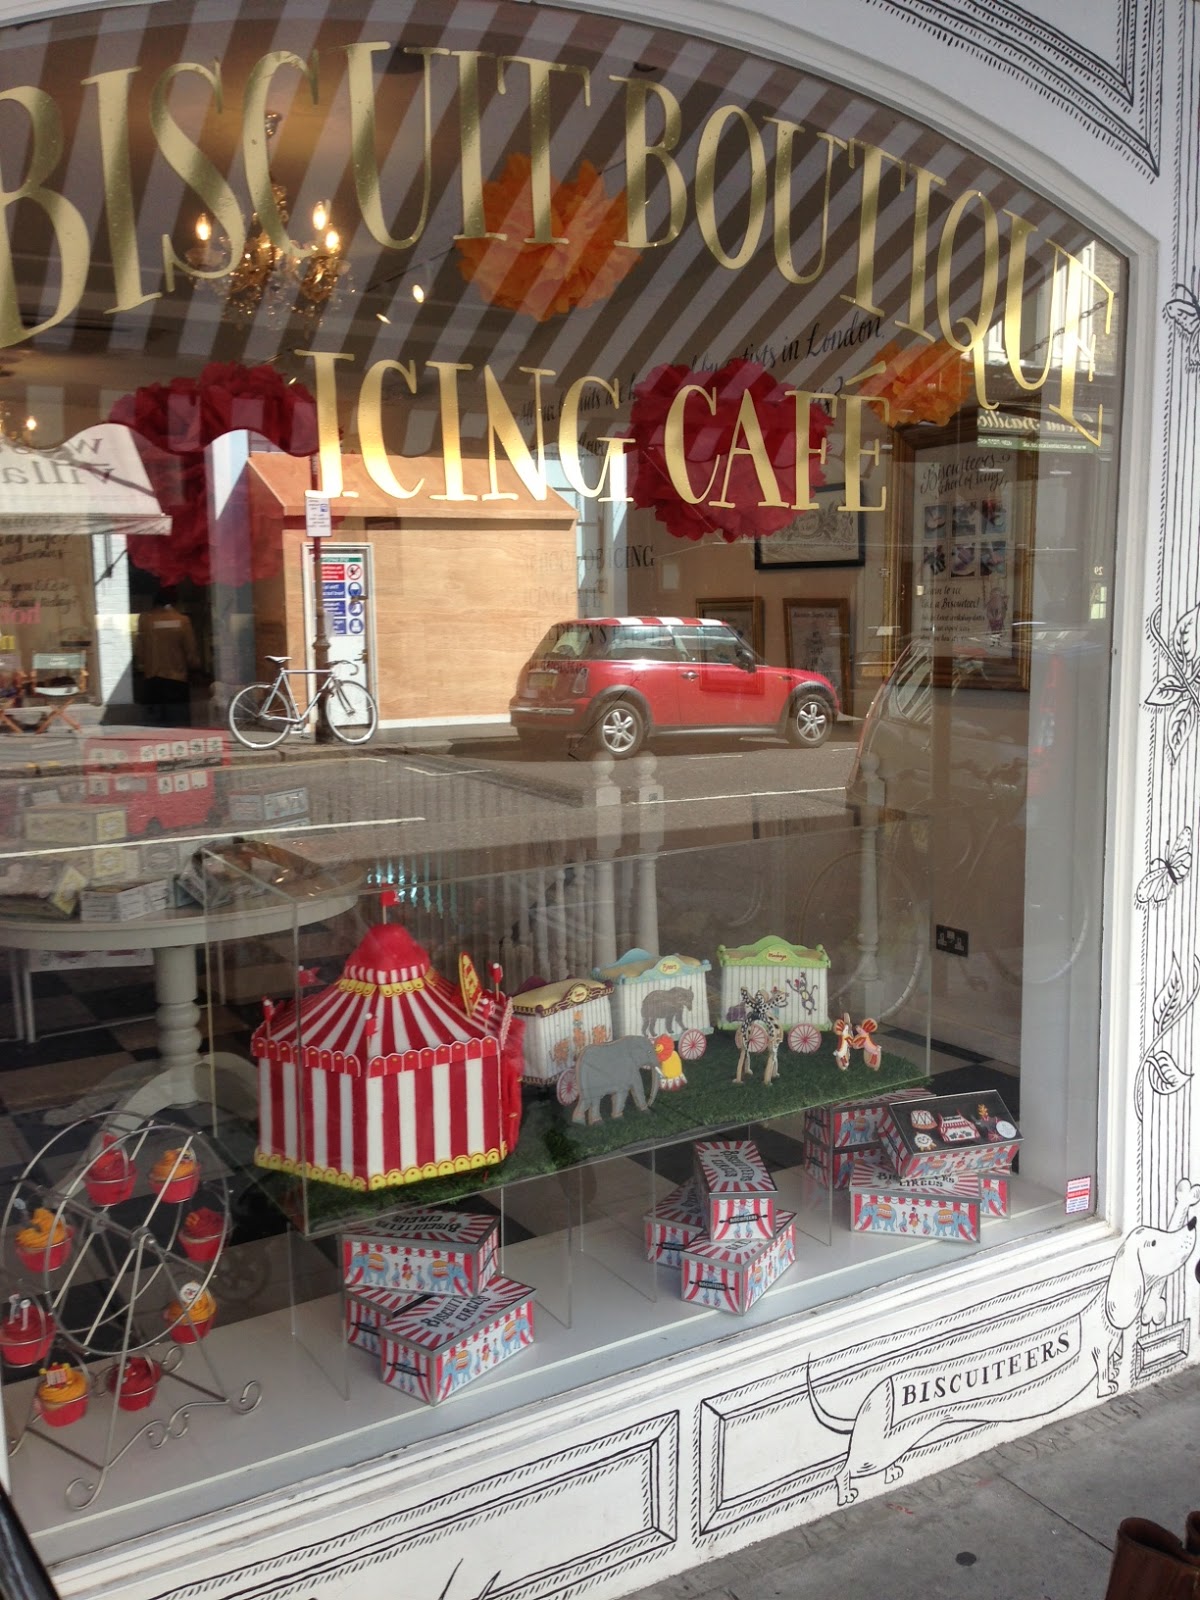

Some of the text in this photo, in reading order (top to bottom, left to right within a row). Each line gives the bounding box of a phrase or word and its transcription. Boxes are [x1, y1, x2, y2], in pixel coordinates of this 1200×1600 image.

[0, 41, 1115, 446] BISCUIT BOUTIQUE
[782, 336, 800, 363] in
[295, 349, 890, 512] ICING CAFÉ
[420, 1296, 464, 1328] BISCUIT
[454, 1294, 492, 1323] CIRCUS
[901, 1330, 1070, 1408] BISCUITEERS
